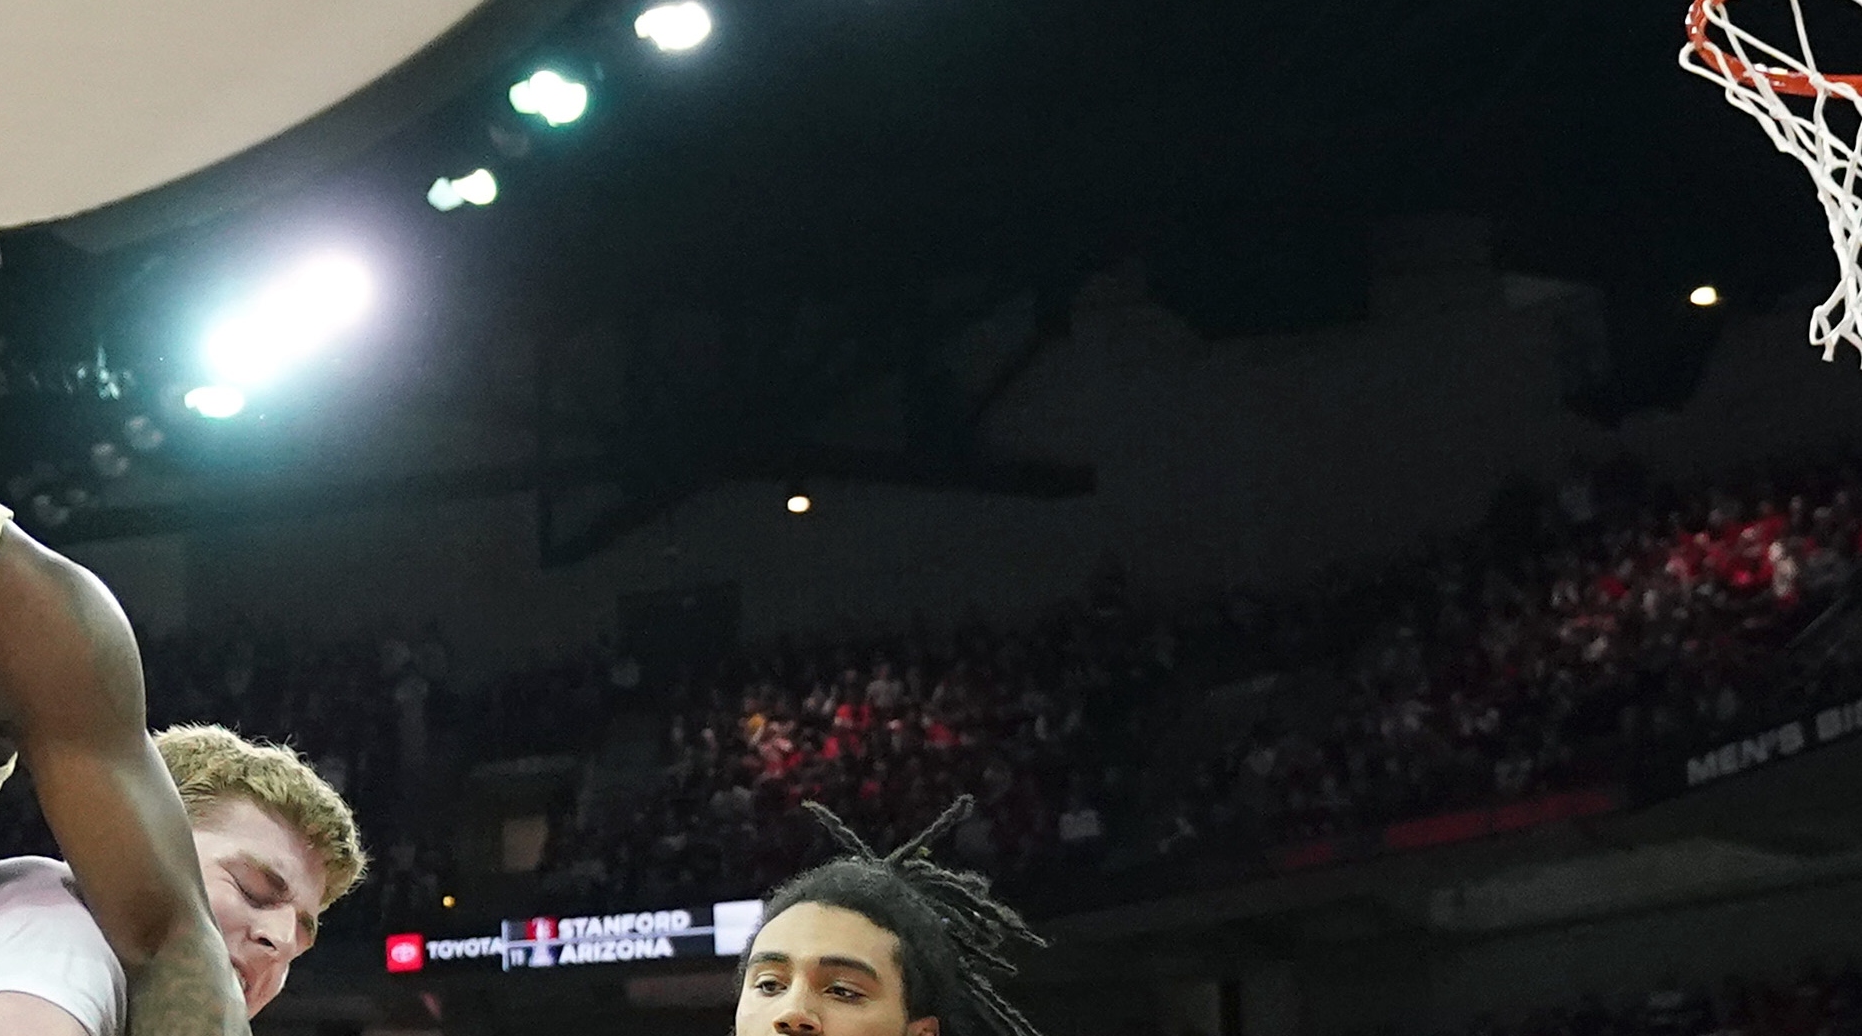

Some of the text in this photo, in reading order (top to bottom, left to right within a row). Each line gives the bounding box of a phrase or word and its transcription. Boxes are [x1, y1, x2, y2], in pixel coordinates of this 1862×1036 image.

[558, 909, 692, 940] STANFORD
[428, 936, 502, 961] TOYOTA
[558, 937, 674, 965] ARIZONA
